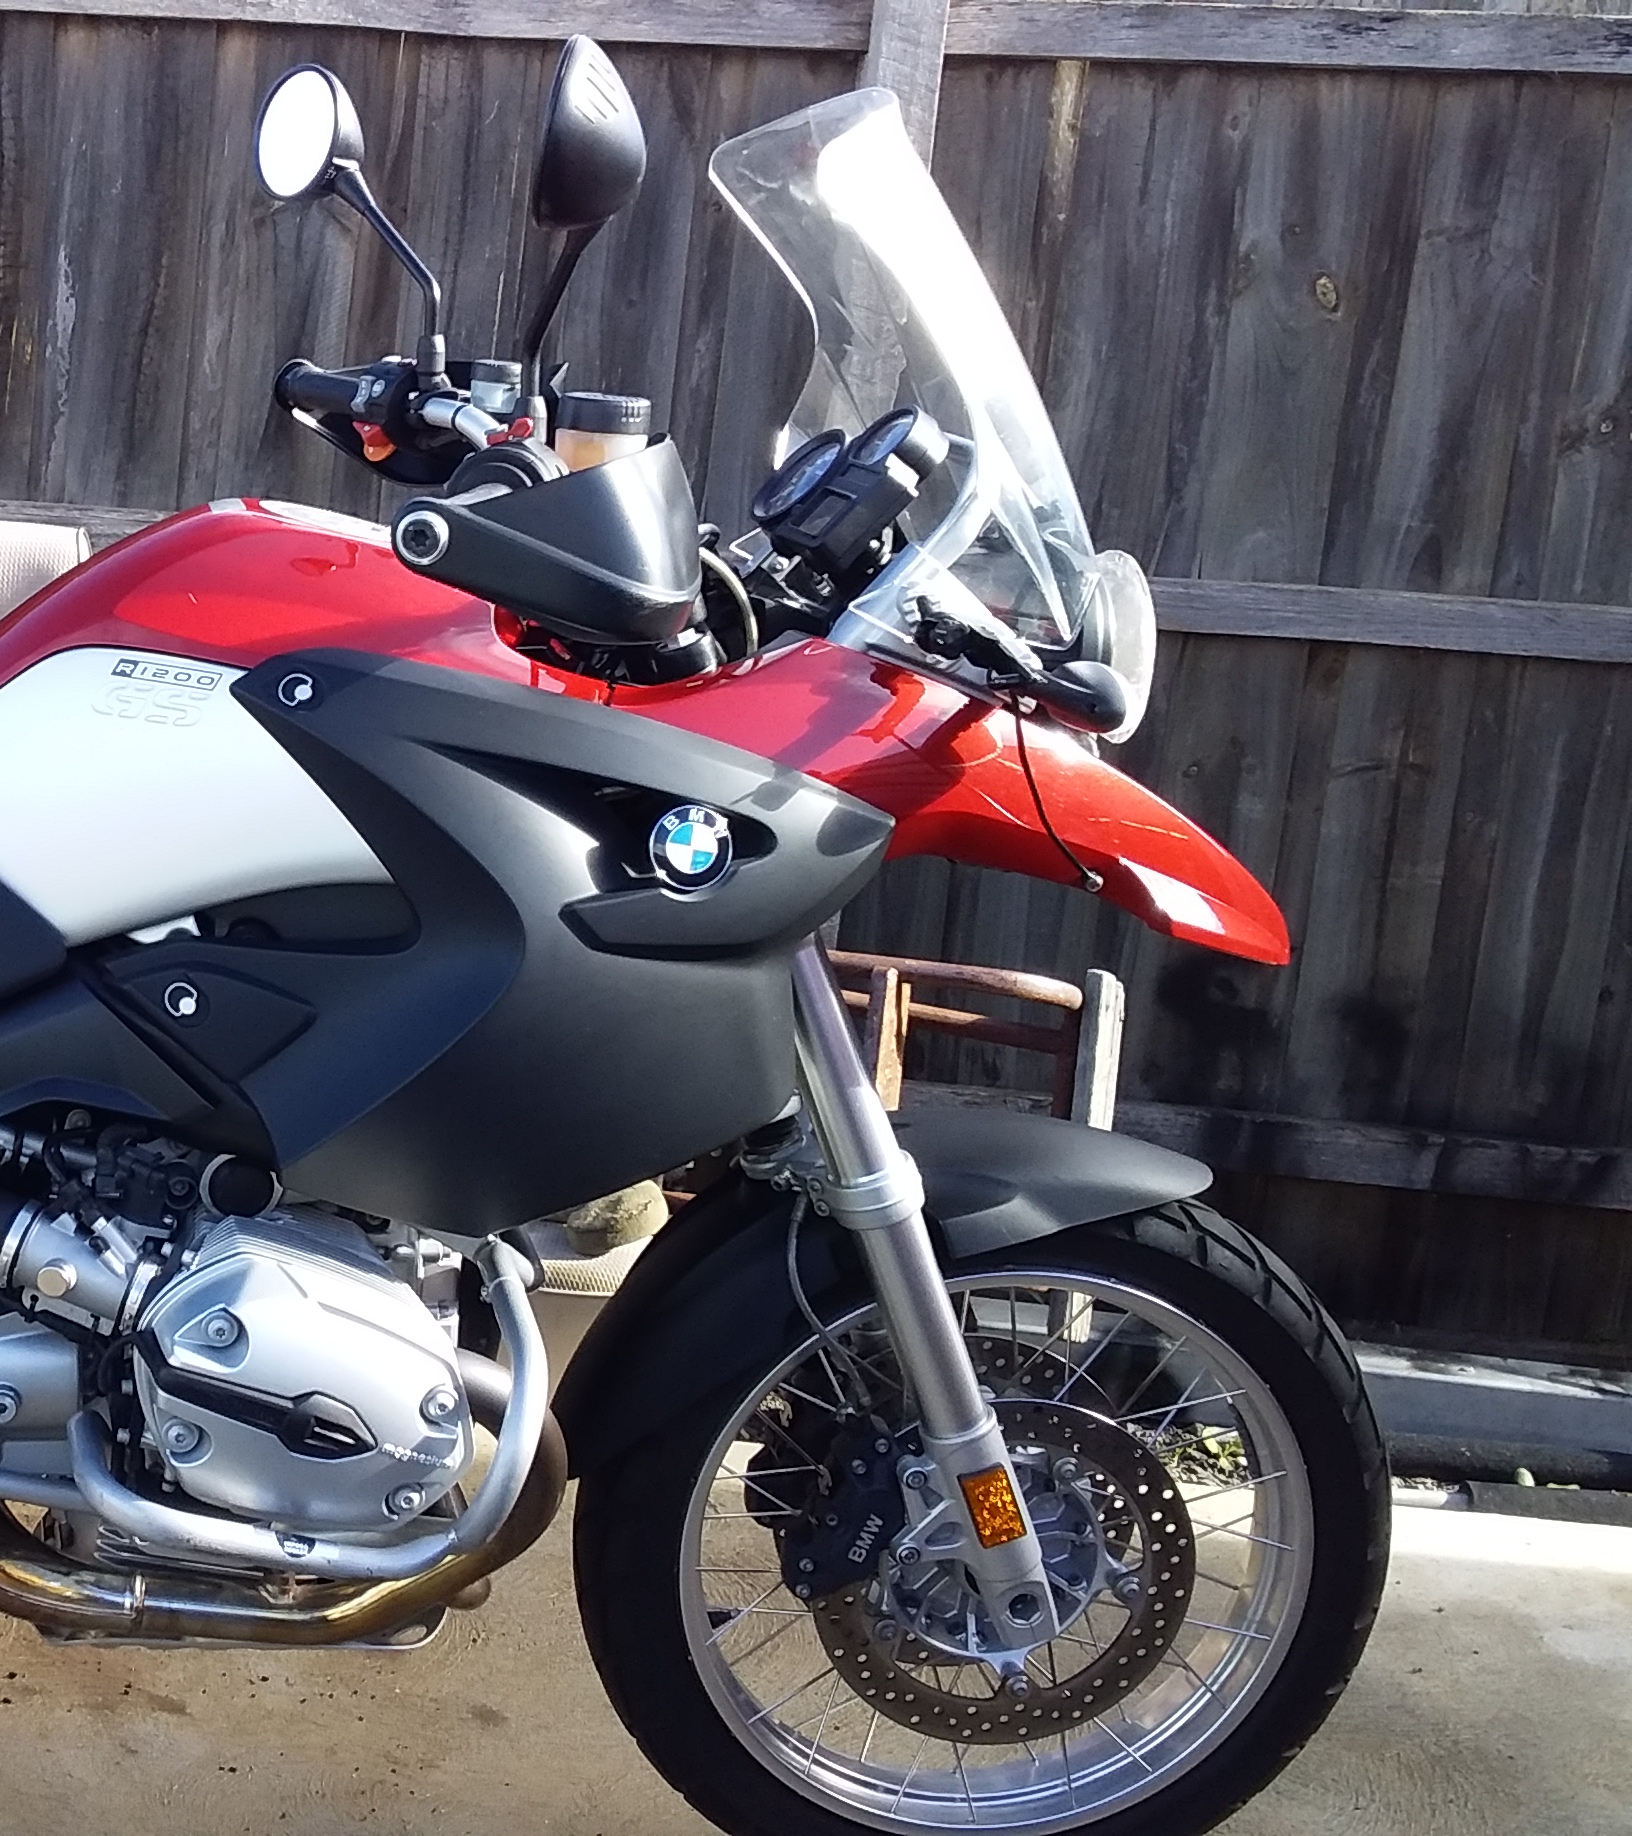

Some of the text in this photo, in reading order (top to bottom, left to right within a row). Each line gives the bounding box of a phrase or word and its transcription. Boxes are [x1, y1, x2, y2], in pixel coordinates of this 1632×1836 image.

[112, 659, 218, 688] R1200
[662, 808, 729, 839] BMW
[847, 1513, 885, 1564] BMW
